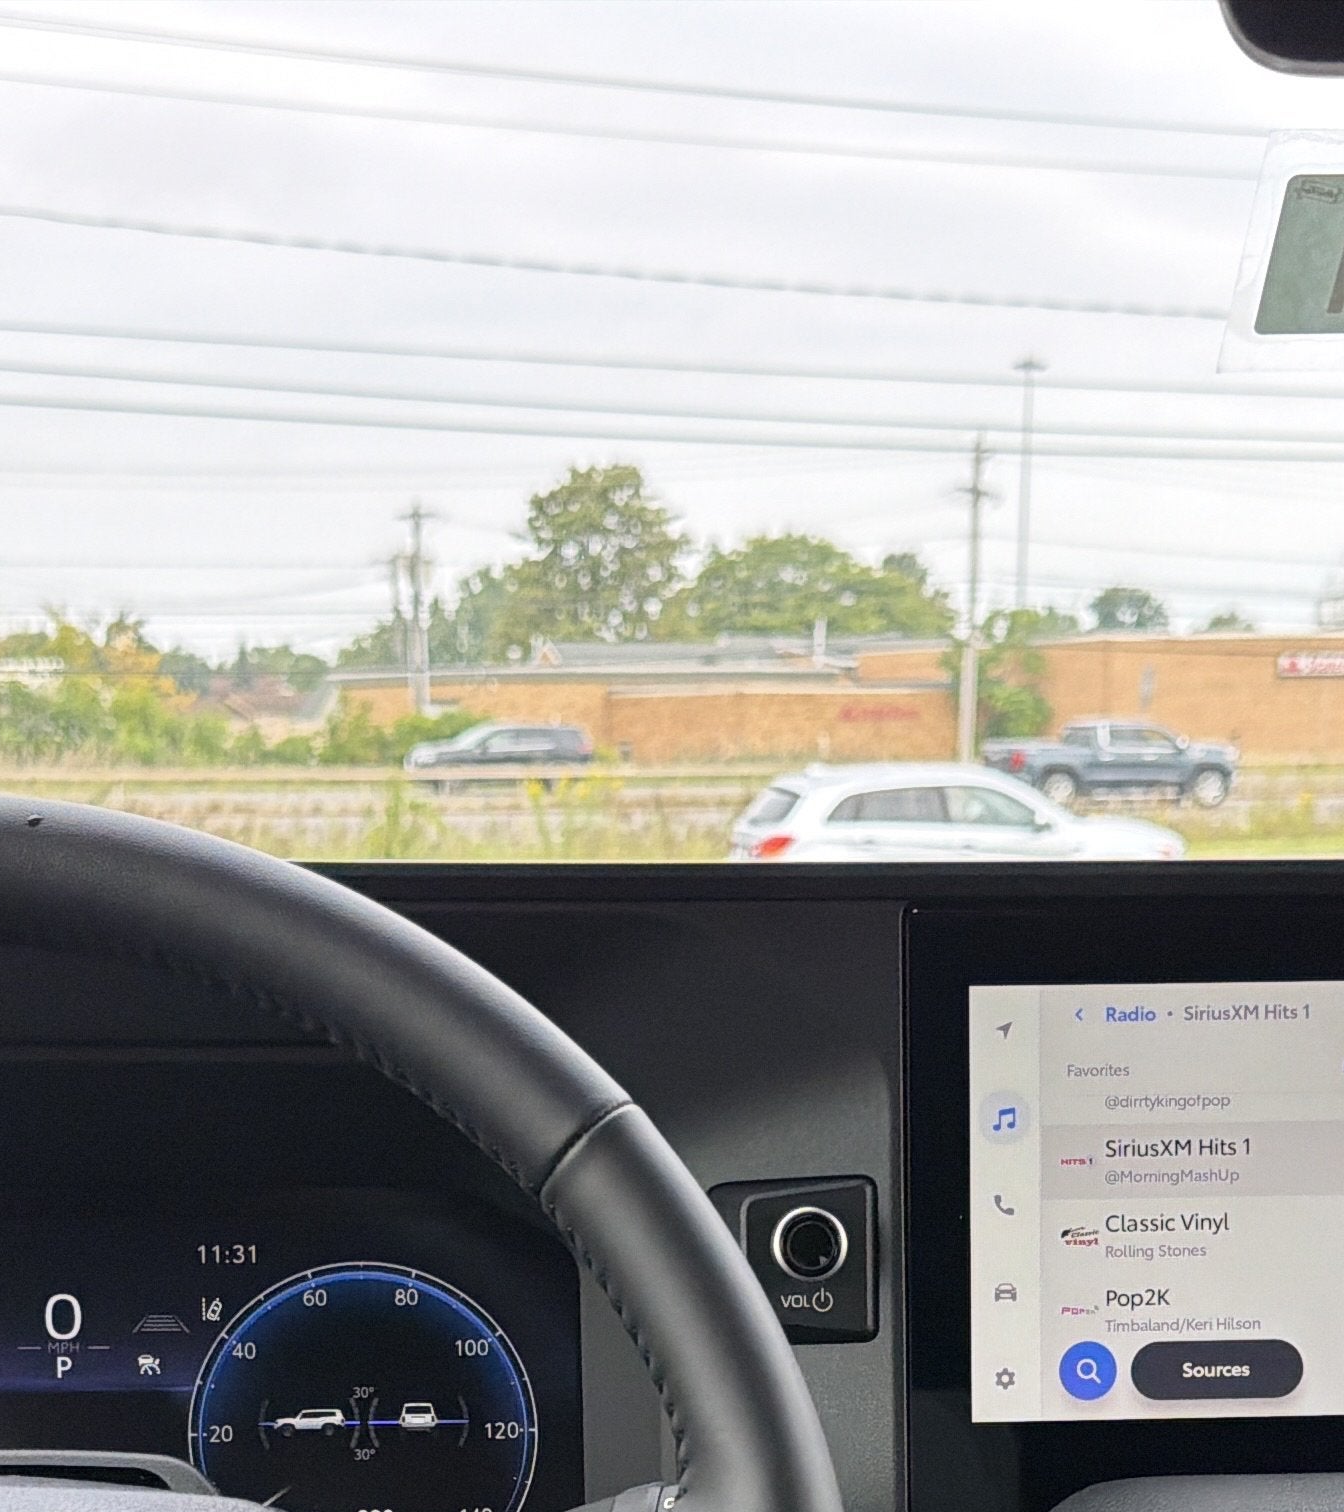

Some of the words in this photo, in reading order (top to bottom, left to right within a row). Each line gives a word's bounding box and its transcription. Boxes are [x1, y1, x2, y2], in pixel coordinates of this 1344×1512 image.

[1106, 1006, 1156, 1022] Radio
[1184, 1005, 1259, 1021] SiriusXM
[1264, 1005, 1298, 1020] Hits
[1303, 1004, 1310, 1019] 1
[1067, 1063, 1130, 1077] Favorites
[1105, 1139, 1192, 1157] SiriusXM
[1199, 1139, 1237, 1155] Hits
[1242, 1139, 1251, 1154] 1
[1061, 1158, 1086, 1166] HITS
[1105, 1168, 1240, 1185] @MorningMashUp
[1105, 1215, 1176, 1232] Classic
[1180, 1213, 1229, 1233] Vinyl
[198, 1245, 256, 1264] 11:31
[1105, 1244, 1154, 1261] Rolling
[1158, 1244, 1206, 1258] Stones
[303, 1289, 326, 1306] 60
[395, 1289, 418, 1305] 80
[781, 1295, 810, 1308] VOL
[1106, 1288, 1170, 1309] Pop2K
[44, 1294, 82, 1340] 0
[1105, 1318, 1212, 1334] Timbaland/Keri
[1217, 1317, 1261, 1330] Hilson
[48, 1342, 80, 1352] MPH
[232, 1342, 256, 1359] 40
[455, 1340, 489, 1357] 100
[57, 1357, 71, 1378] P
[1182, 1363, 1250, 1377] Sources
[210, 1426, 232, 1443] 20
[485, 1423, 519, 1439] 120
